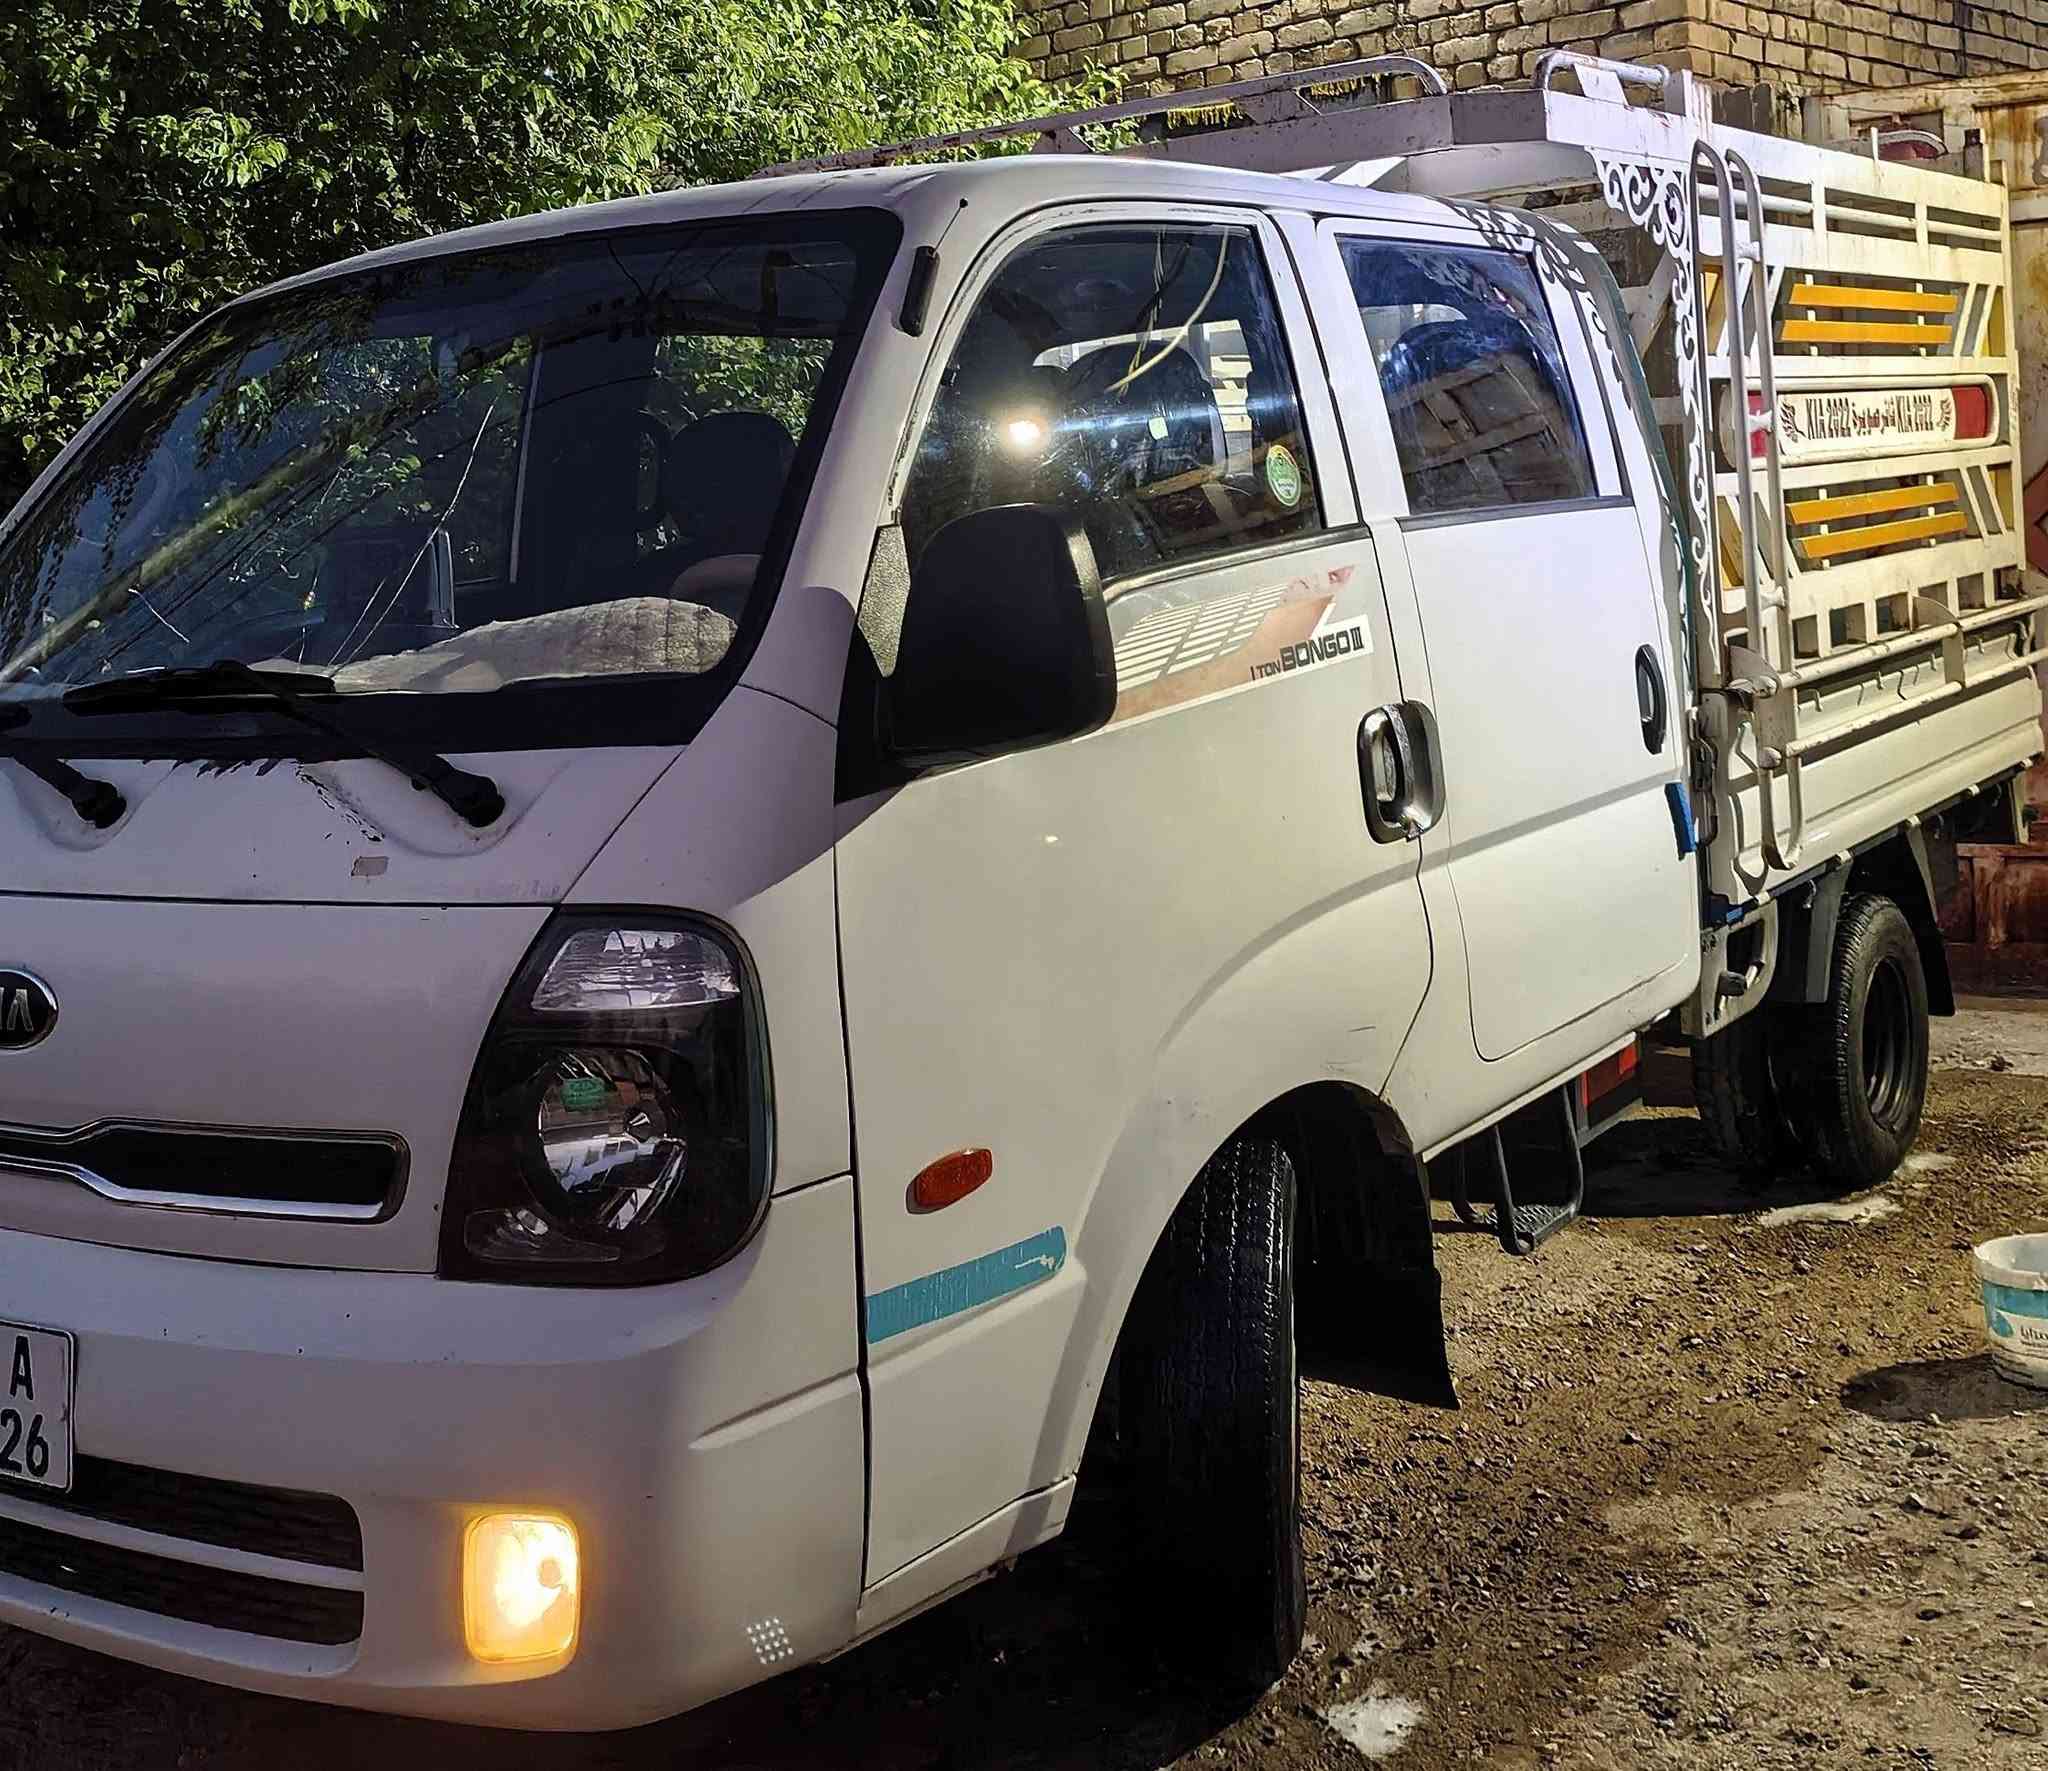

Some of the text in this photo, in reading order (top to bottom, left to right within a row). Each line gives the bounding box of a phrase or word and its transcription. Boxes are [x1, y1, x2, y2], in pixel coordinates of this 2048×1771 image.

[1805, 398, 1826, 440] KIA
[1256, 659, 1281, 678] TON
[1279, 630, 1350, 672] BONGO
[9, 1335, 34, 1401] A
[0, 1408, 49, 1478] 26
